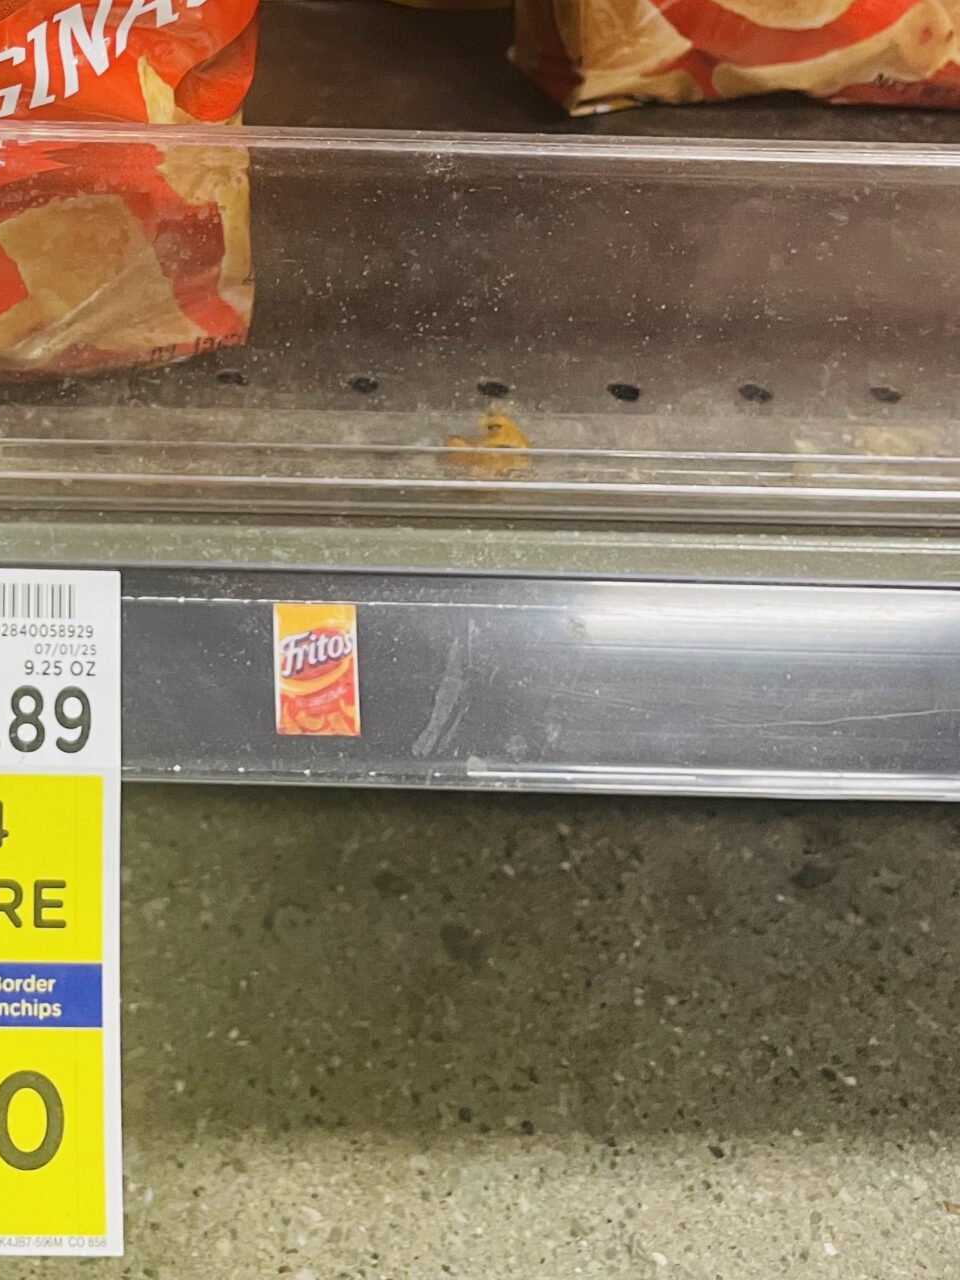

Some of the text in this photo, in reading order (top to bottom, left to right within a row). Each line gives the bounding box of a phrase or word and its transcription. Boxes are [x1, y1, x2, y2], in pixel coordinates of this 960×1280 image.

[34, 643, 97, 657] 07/01/25
[280, 631, 355, 678] Fritos
[24, 661, 63, 677] 9.25
[70, 661, 97, 677] OZ
